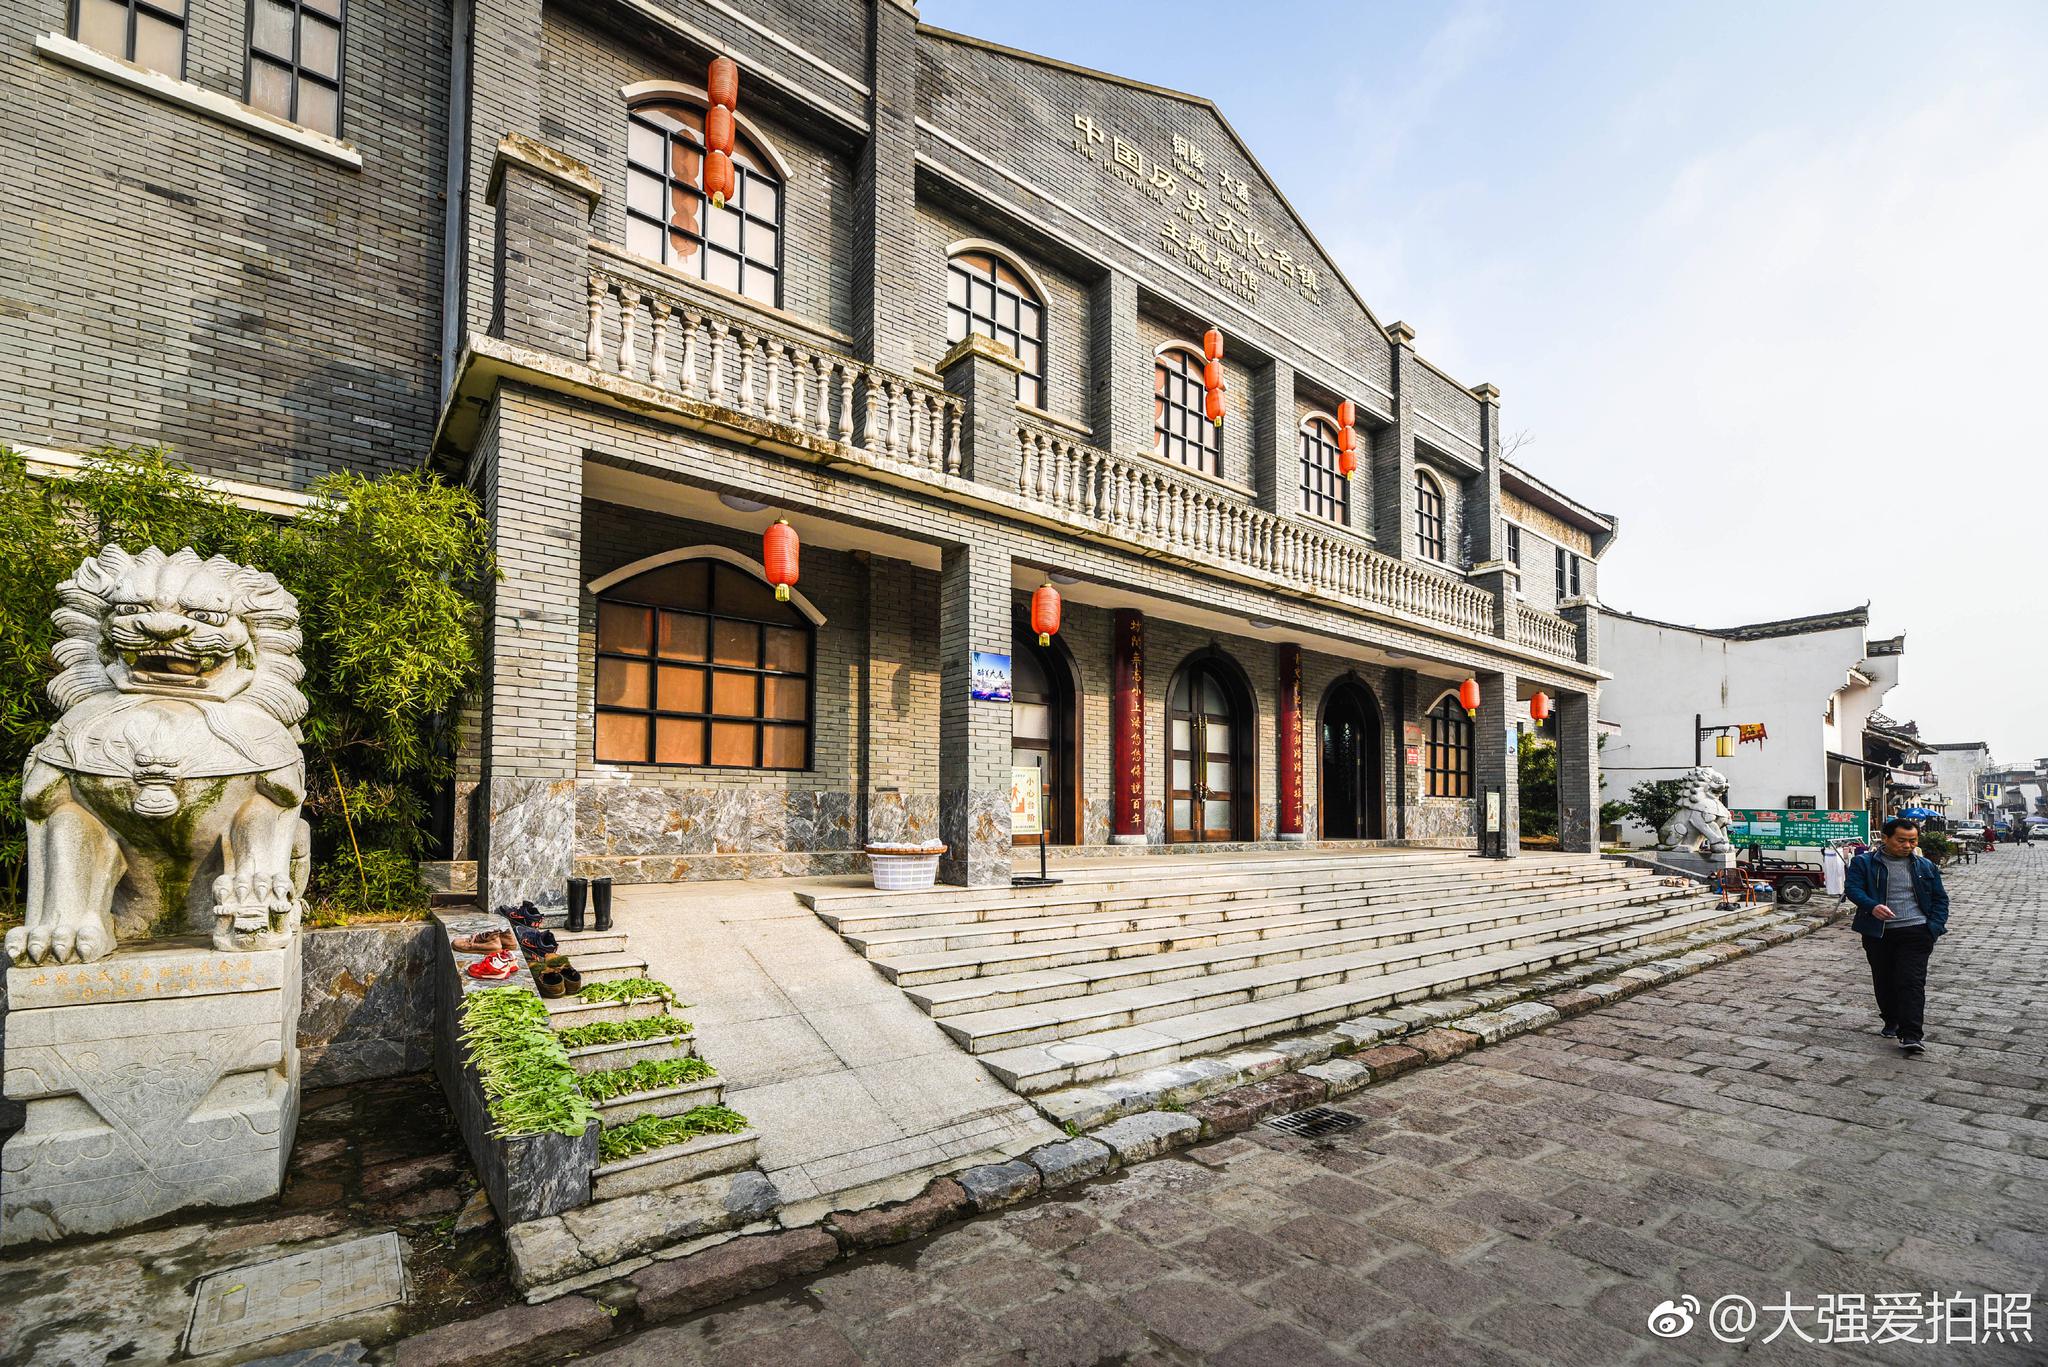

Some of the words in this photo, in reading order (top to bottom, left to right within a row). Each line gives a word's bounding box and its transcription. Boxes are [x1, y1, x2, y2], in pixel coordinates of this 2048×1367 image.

[1073, 114, 1320, 292] 中国历史文化名镇
[1171, 132, 1206, 173] 铜陵
[1219, 169, 1250, 206] 大通
[1172, 156, 1209, 190] TONGLING
[1221, 192, 1251, 219] DATONG
[1073, 140, 1095, 161] THE
[1103, 159, 1164, 205] HISTORICAL
[1175, 206, 1195, 224] AND
[1207, 226, 1249, 261] CULTURAL
[1256, 259, 1280, 280] TOWN
[1284, 276, 1294, 289] OF
[1300, 286, 1320, 308] CHINA
[1161, 219, 1258, 293] 主题展馆
[1161, 240, 1178, 258] THE
[1184, 253, 1213, 280] THEME
[1219, 275, 1258, 304] GALLERY
